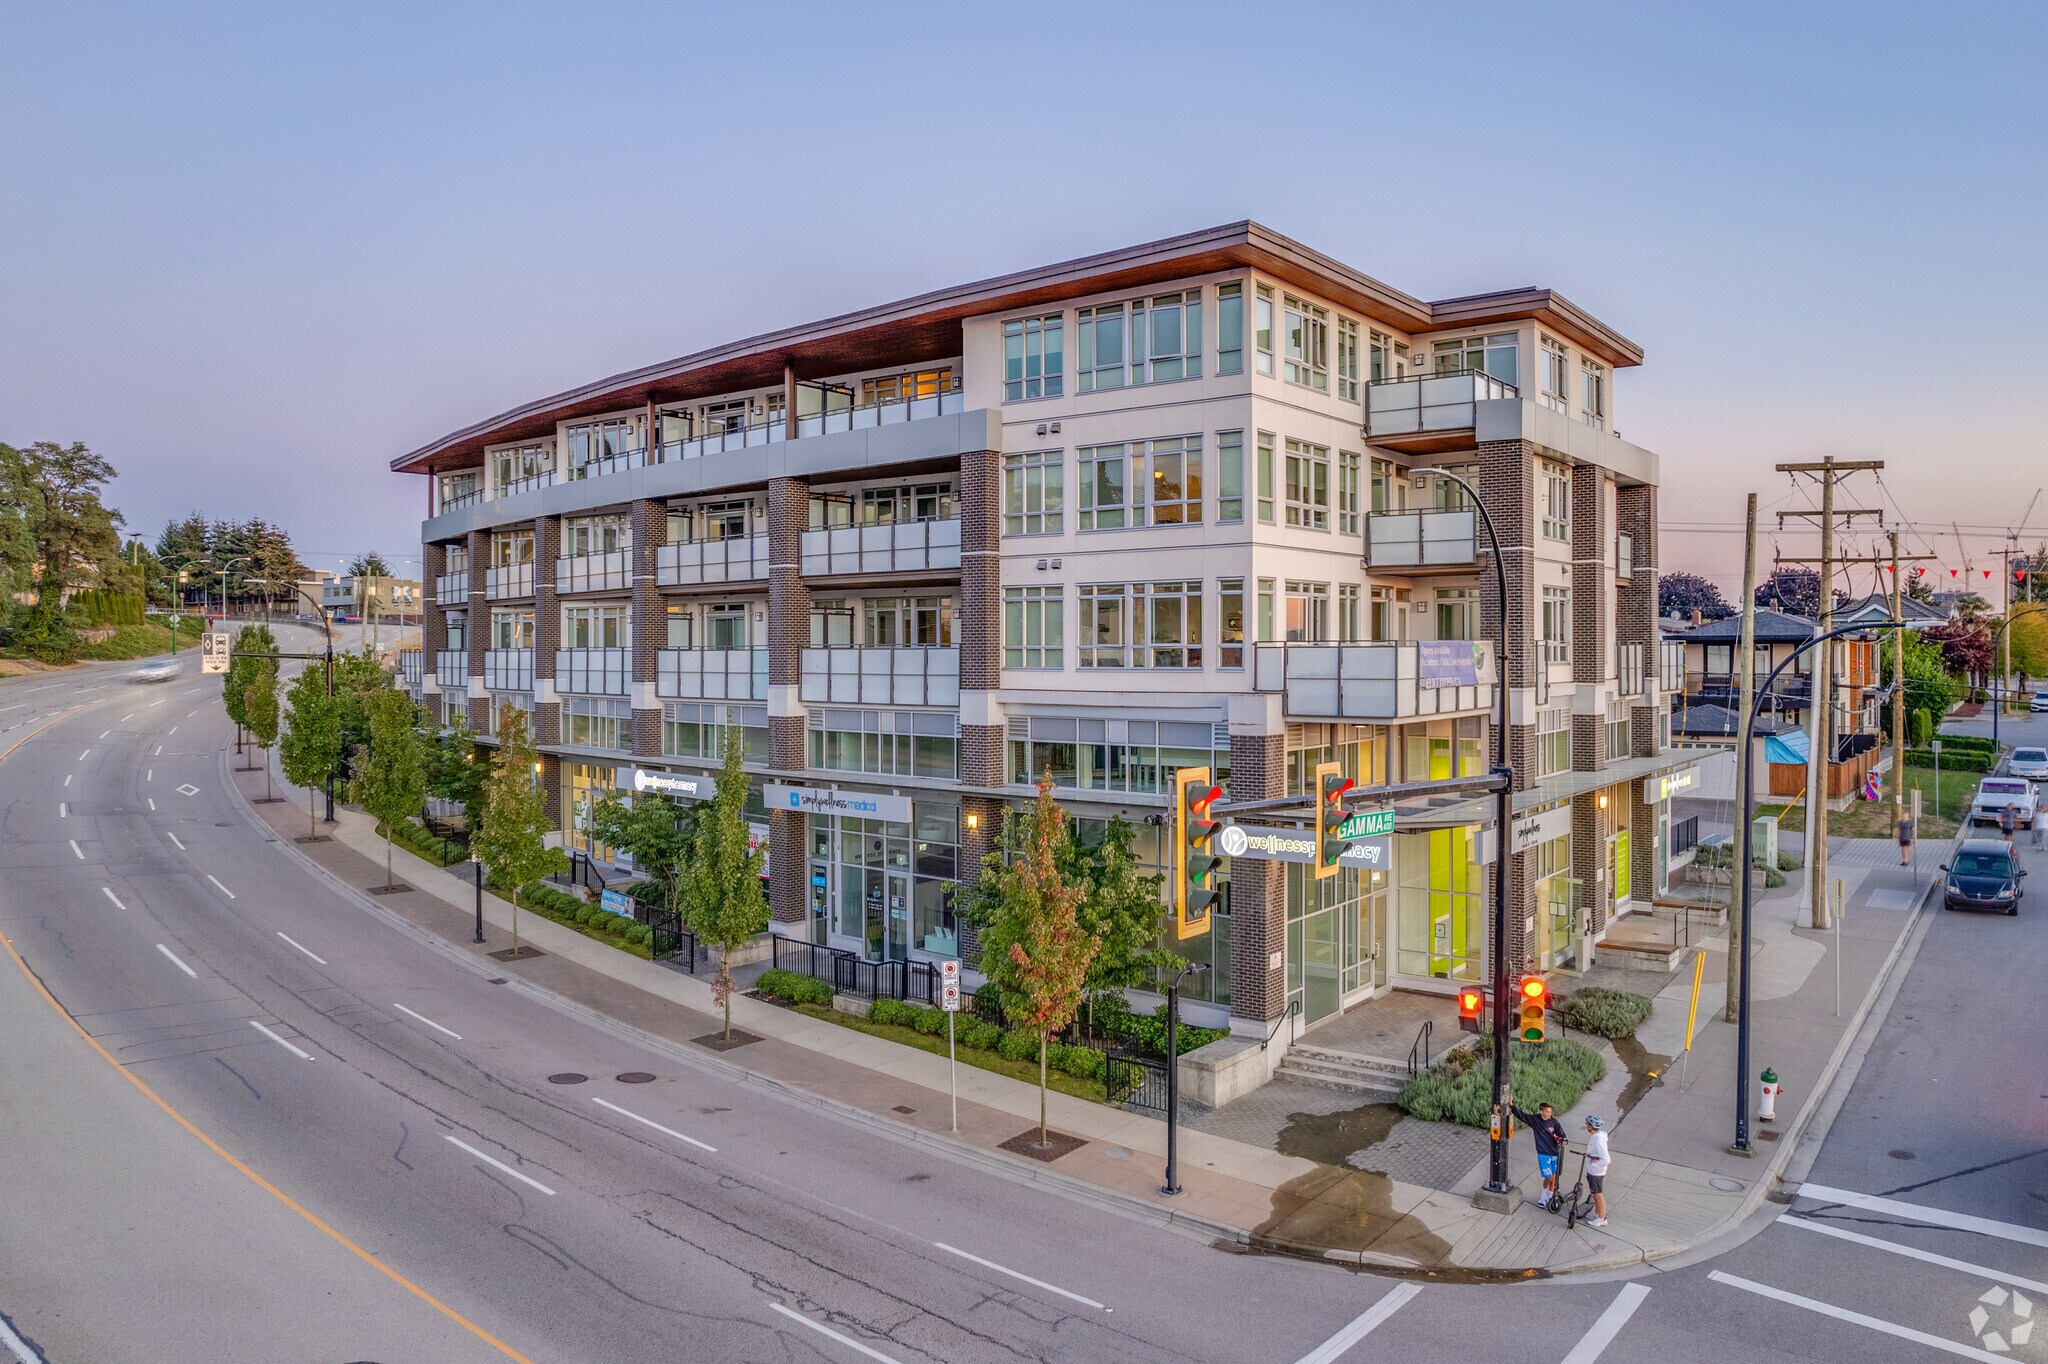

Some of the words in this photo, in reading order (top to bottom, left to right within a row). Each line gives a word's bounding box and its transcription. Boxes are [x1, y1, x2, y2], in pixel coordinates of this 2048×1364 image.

[1340, 815, 1383, 838] GAMMA
[1384, 813, 1392, 822] AVE
[1248, 835, 1381, 863] wellnesspacy
